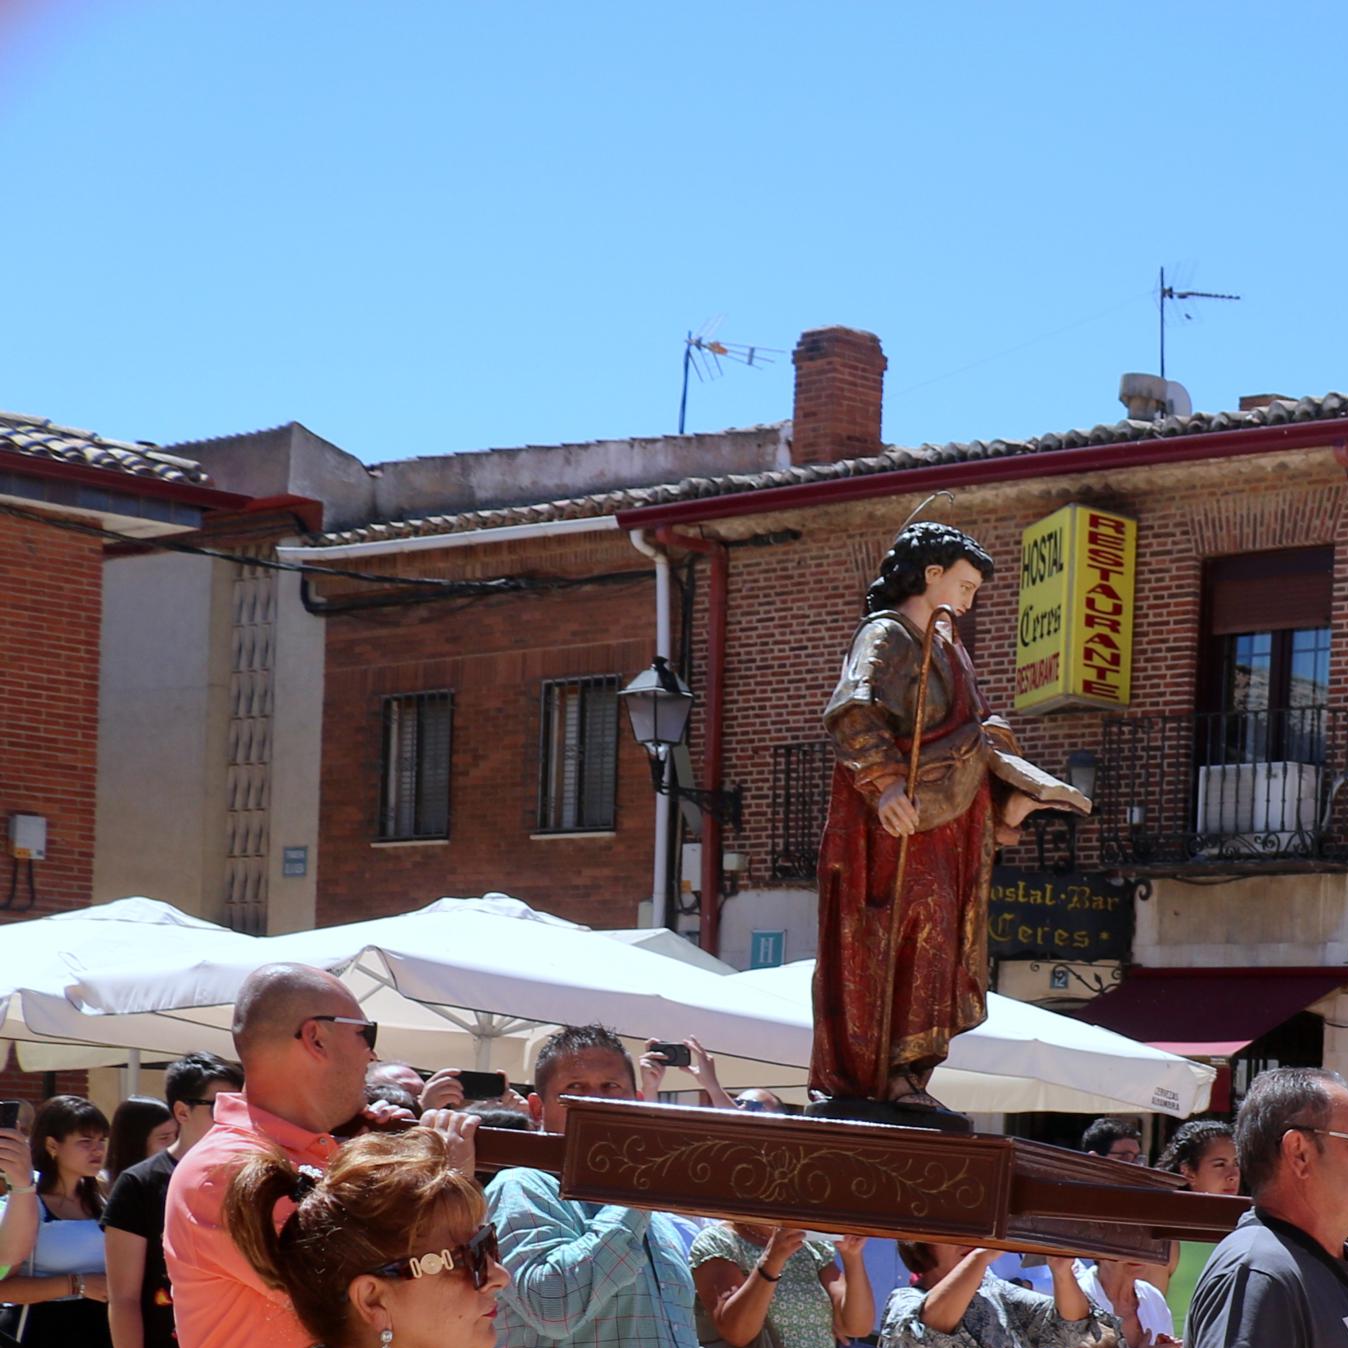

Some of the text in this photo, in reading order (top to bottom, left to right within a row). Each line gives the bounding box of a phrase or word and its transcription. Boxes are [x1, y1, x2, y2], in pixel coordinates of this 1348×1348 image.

[1021, 527, 1064, 590] HOSTAL
[1019, 604, 1062, 648] Ceres
[1083, 513, 1126, 700] RESTAURANTE
[1016, 652, 1060, 695] RESTAURANTE
[990, 880, 1119, 911] ostal Bar
[988, 912, 1090, 947] Ceres
